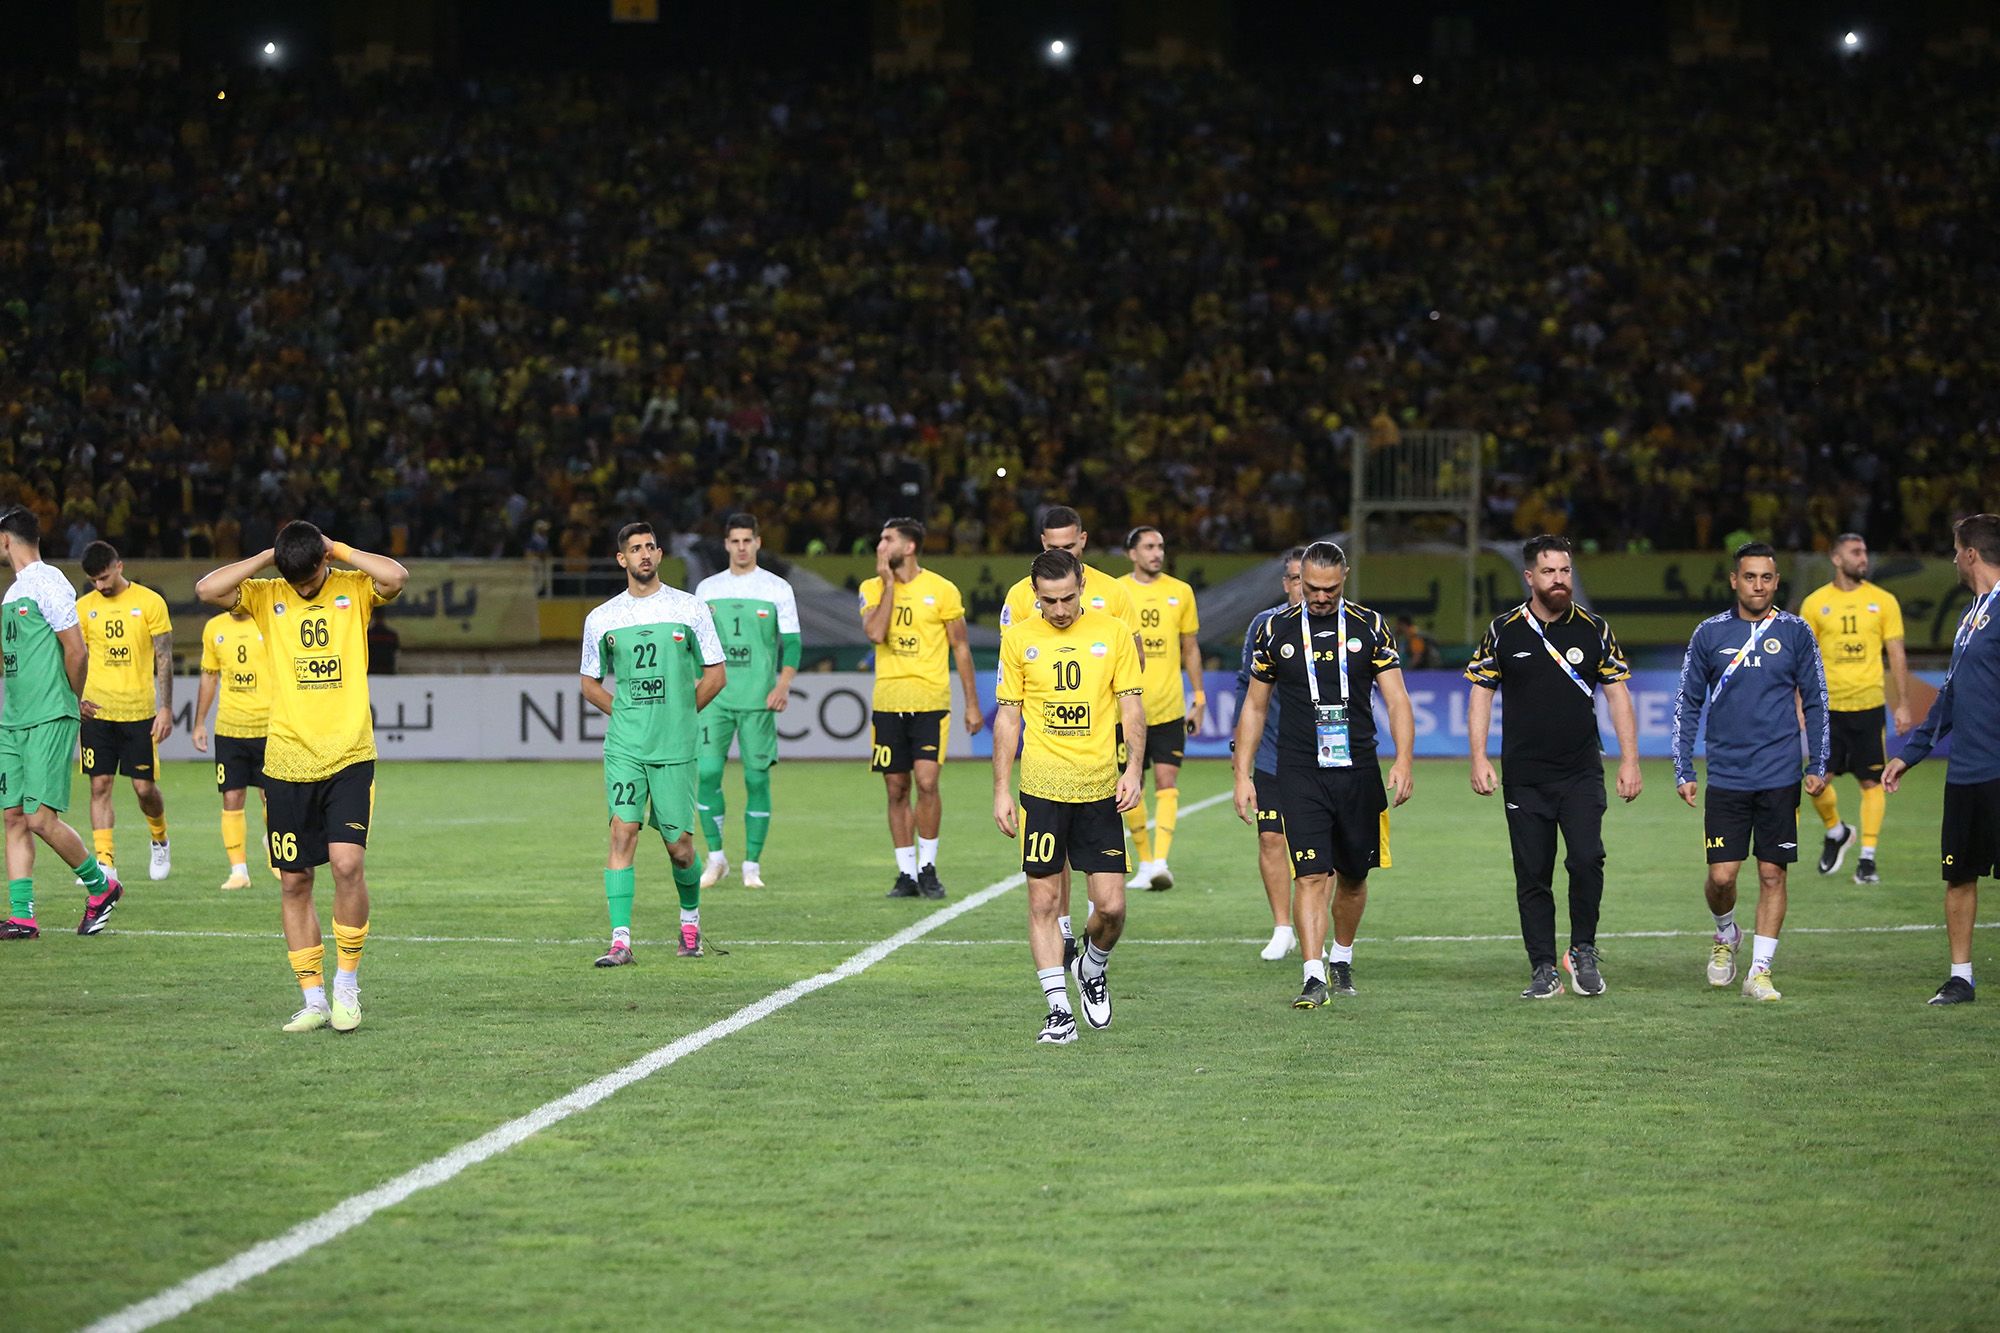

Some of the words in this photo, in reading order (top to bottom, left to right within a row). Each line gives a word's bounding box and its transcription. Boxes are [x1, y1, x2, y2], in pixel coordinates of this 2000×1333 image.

[733, 617, 742, 637] 1
[895, 606, 913, 627] 70
[1141, 608, 1160, 628] 99
[1841, 615, 1858, 635] 11
[105, 619, 124, 639] 58
[300, 618, 330, 648] 66
[237, 644, 247, 664] 8
[633, 643, 658, 669] 22
[1052, 661, 1081, 691] 10
[702, 726, 711, 745] 1
[872, 744, 892, 768] 70
[216, 763, 227, 785] 8
[612, 781, 637, 806] 22
[271, 830, 298, 862] 66
[1025, 831, 1056, 863] 10
[1296, 849, 1316, 862] P.S
